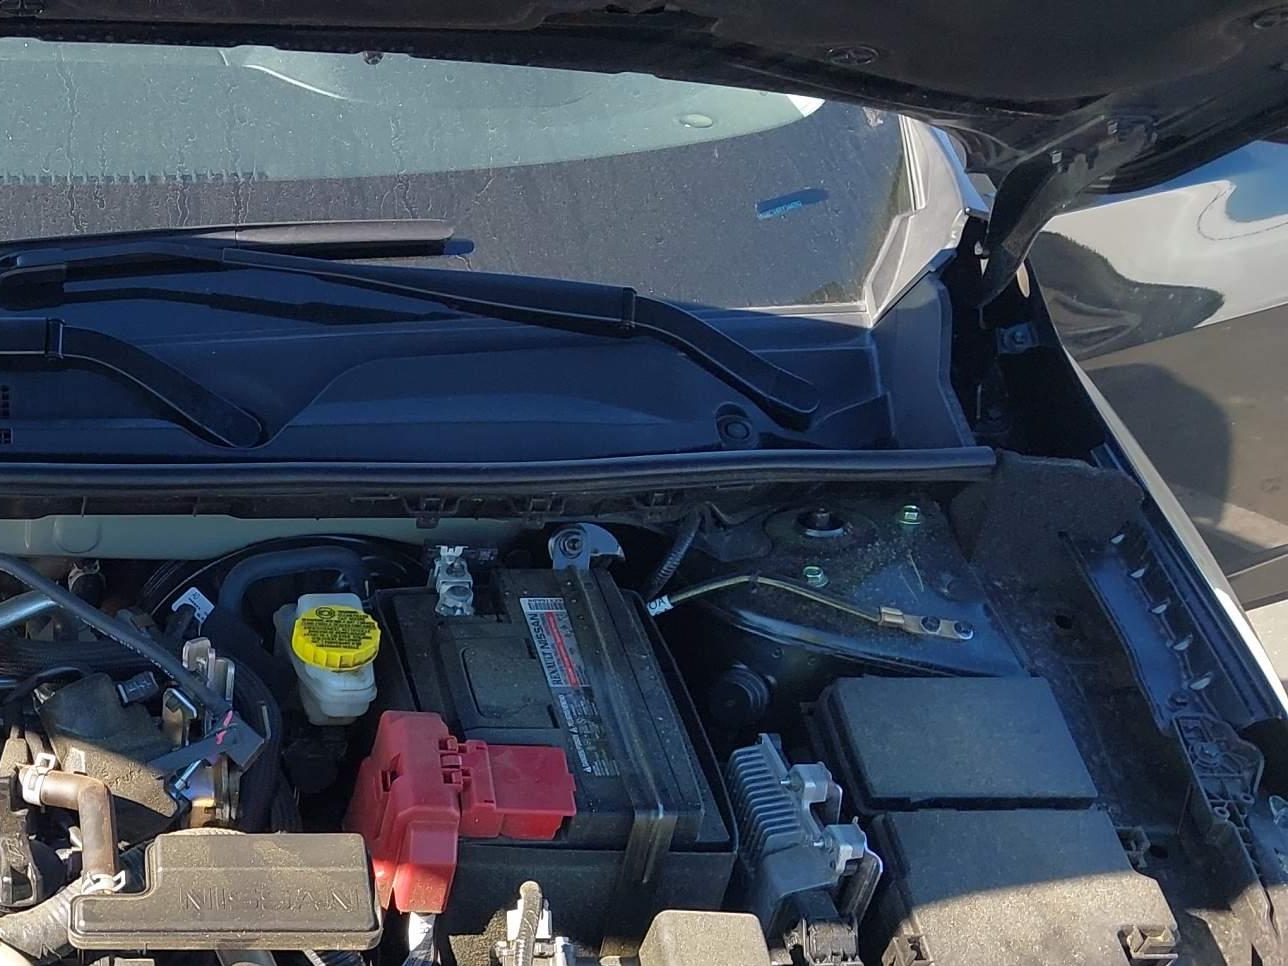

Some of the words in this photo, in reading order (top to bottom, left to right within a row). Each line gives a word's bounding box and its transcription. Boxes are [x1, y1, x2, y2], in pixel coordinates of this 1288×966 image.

[527, 613, 551, 650] NISSAN
[542, 650, 564, 686] RENAULT
[179, 886, 360, 912] NISSAN
